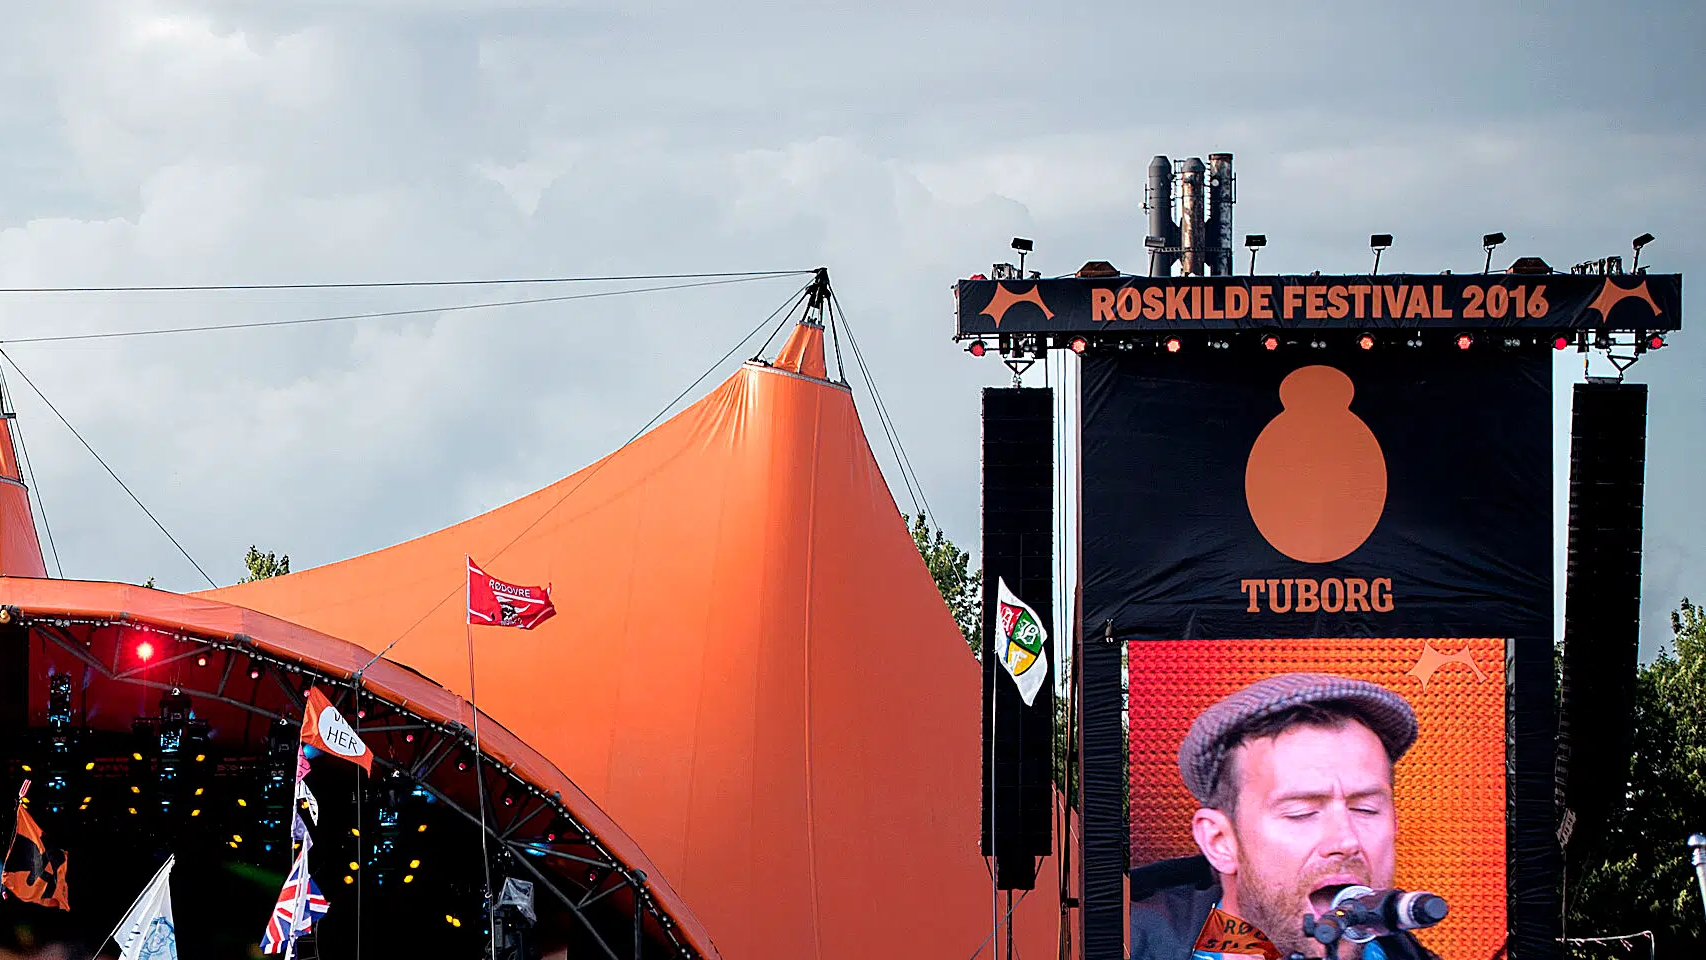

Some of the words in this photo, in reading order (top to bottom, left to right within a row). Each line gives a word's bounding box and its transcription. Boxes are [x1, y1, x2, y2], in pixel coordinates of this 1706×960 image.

[1091, 286, 1273, 321] ROSKILDE
[1283, 284, 1453, 320] FESTIVAL
[1462, 284, 1549, 319] 2016
[488, 578, 531, 598] RØDOVRE
[1240, 577, 1395, 614] TUBORG
[326, 726, 358, 754] HER
